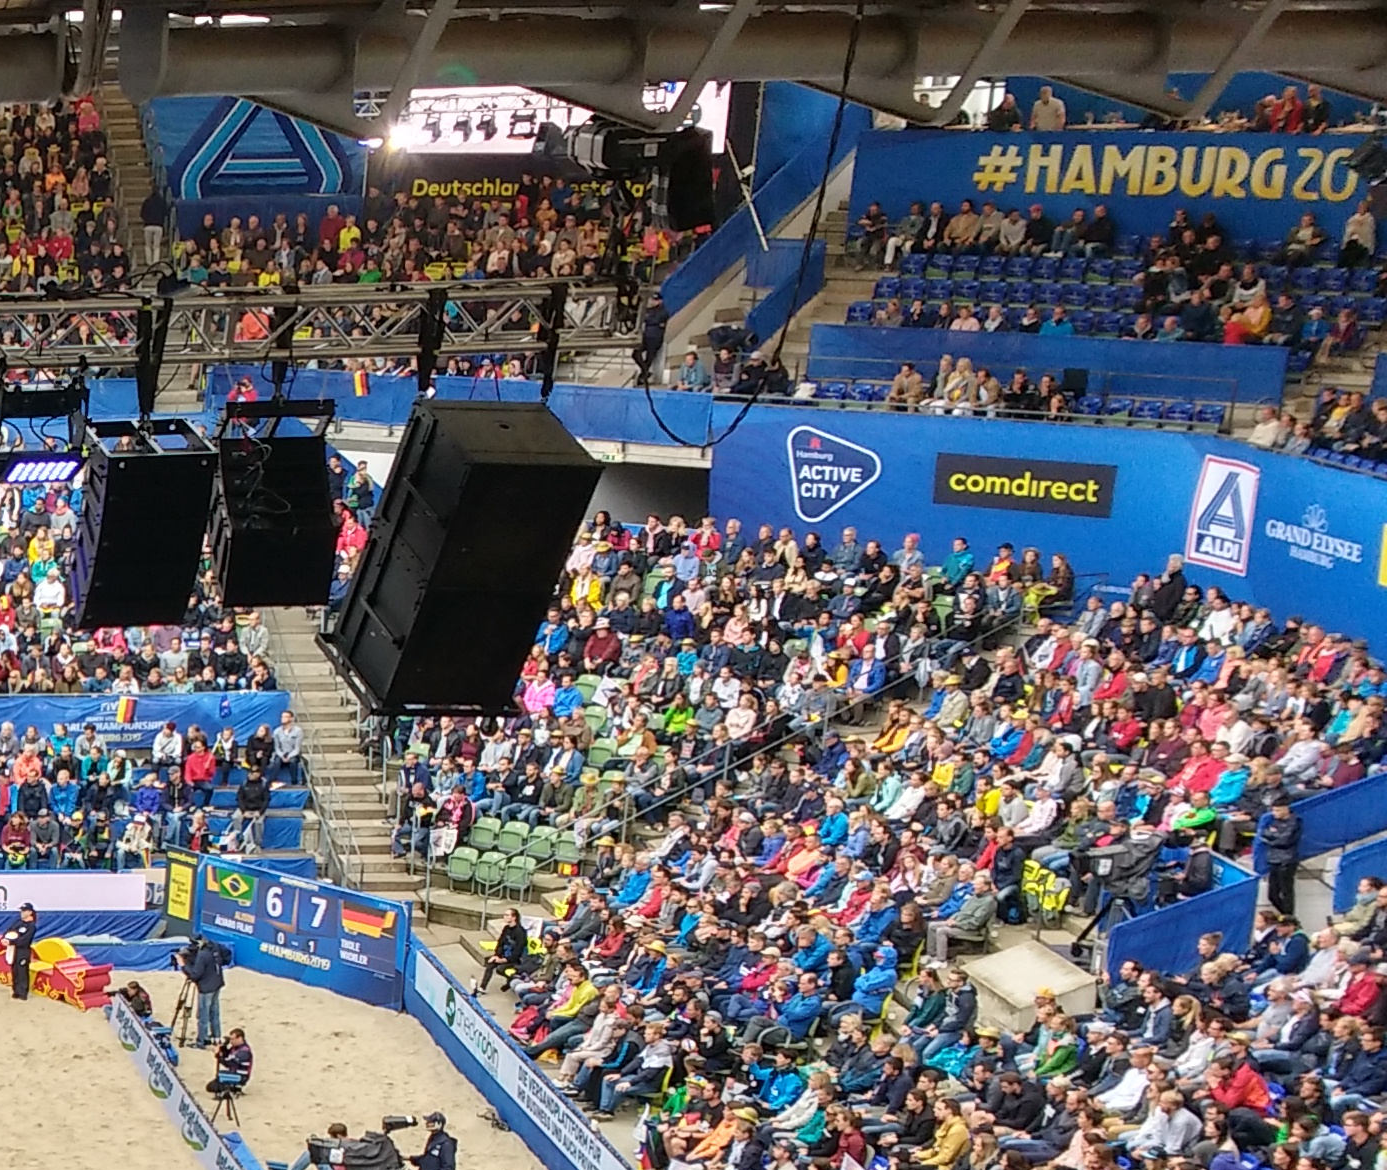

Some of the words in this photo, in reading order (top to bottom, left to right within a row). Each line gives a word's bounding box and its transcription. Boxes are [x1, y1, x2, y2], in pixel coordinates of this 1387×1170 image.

[972, 144, 1359, 201] #HAMBURG20
[412, 178, 519, 197] Deutschla
[796, 450, 833, 461] Hamburg
[799, 465, 863, 483] ACTIVE
[949, 471, 1100, 502] comdirect
[800, 483, 840, 499] CITY
[1199, 535, 1241, 561] ALDI
[1266, 519, 1313, 551] GRAND
[1314, 532, 1362, 562] ELYSEE
[266, 886, 283, 917] 6
[310, 896, 328, 928] 7
[277, 932, 285, 945] 0
[308, 940, 315, 952] 1
[456, 1004, 500, 1064] checkrobin
